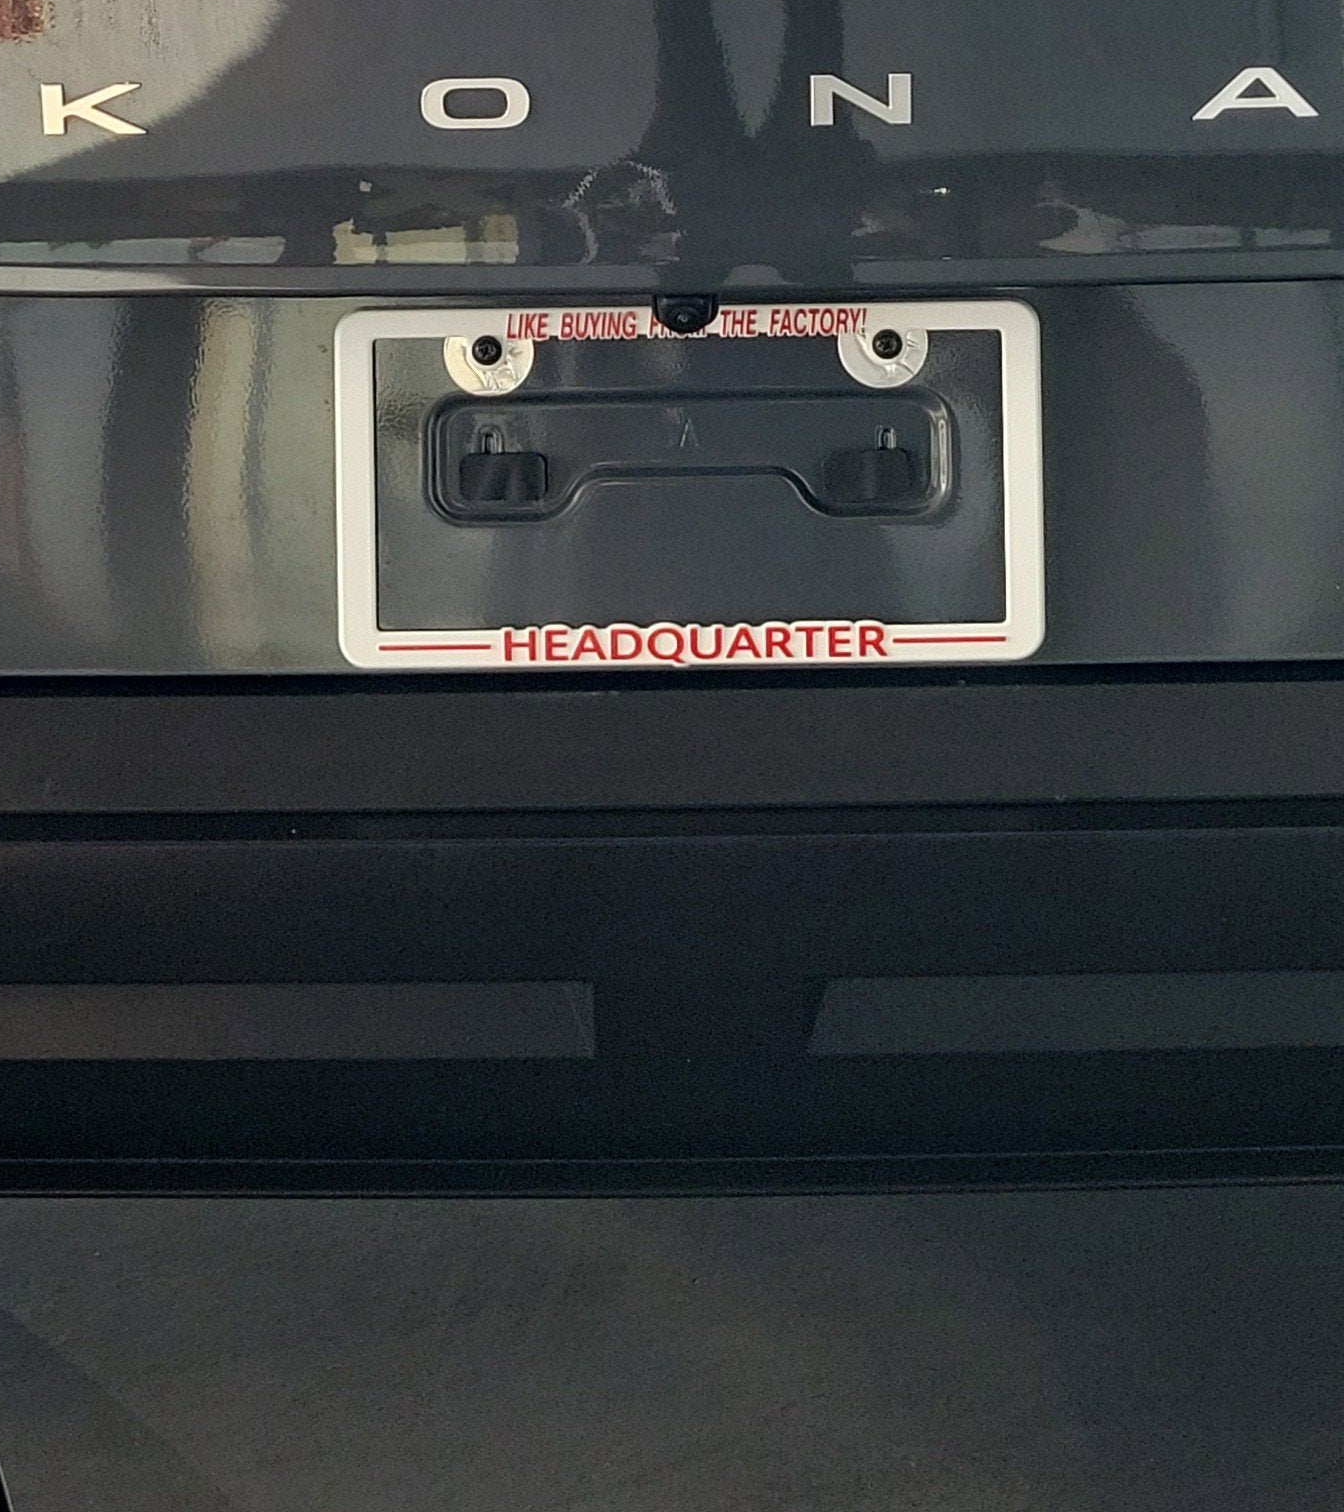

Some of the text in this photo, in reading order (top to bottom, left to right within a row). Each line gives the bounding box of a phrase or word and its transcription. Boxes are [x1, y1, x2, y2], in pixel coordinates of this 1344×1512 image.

[41, 66, 1318, 137] KONA
[506, 313, 548, 339] LIKE
[560, 311, 637, 338] BUYING
[720, 309, 757, 336] THE
[768, 307, 868, 335] FACTORY!
[503, 625, 888, 665] HEADQUARTER
